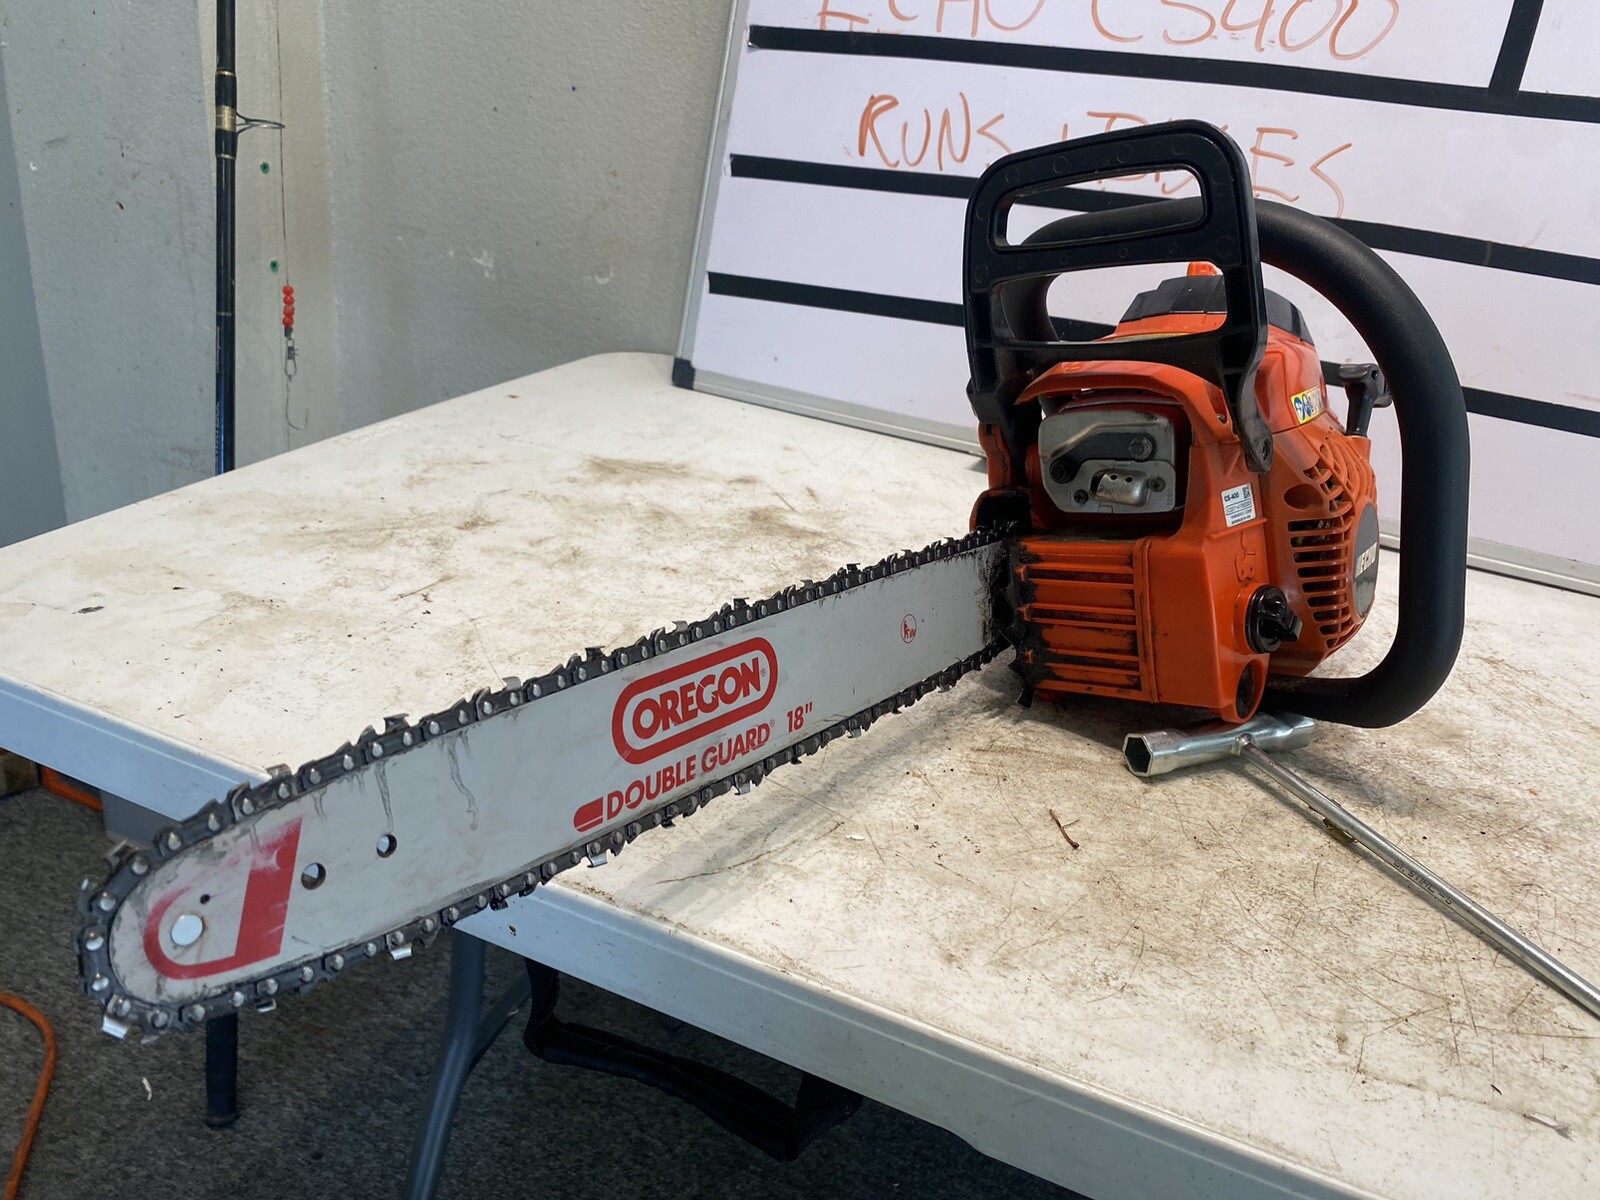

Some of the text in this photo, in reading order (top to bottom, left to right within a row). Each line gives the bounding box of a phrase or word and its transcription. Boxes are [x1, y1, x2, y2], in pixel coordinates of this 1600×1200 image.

[632, 657, 761, 740] OREGON
[606, 754, 697, 821] DOUBLE
[786, 701, 813, 734] 18"
